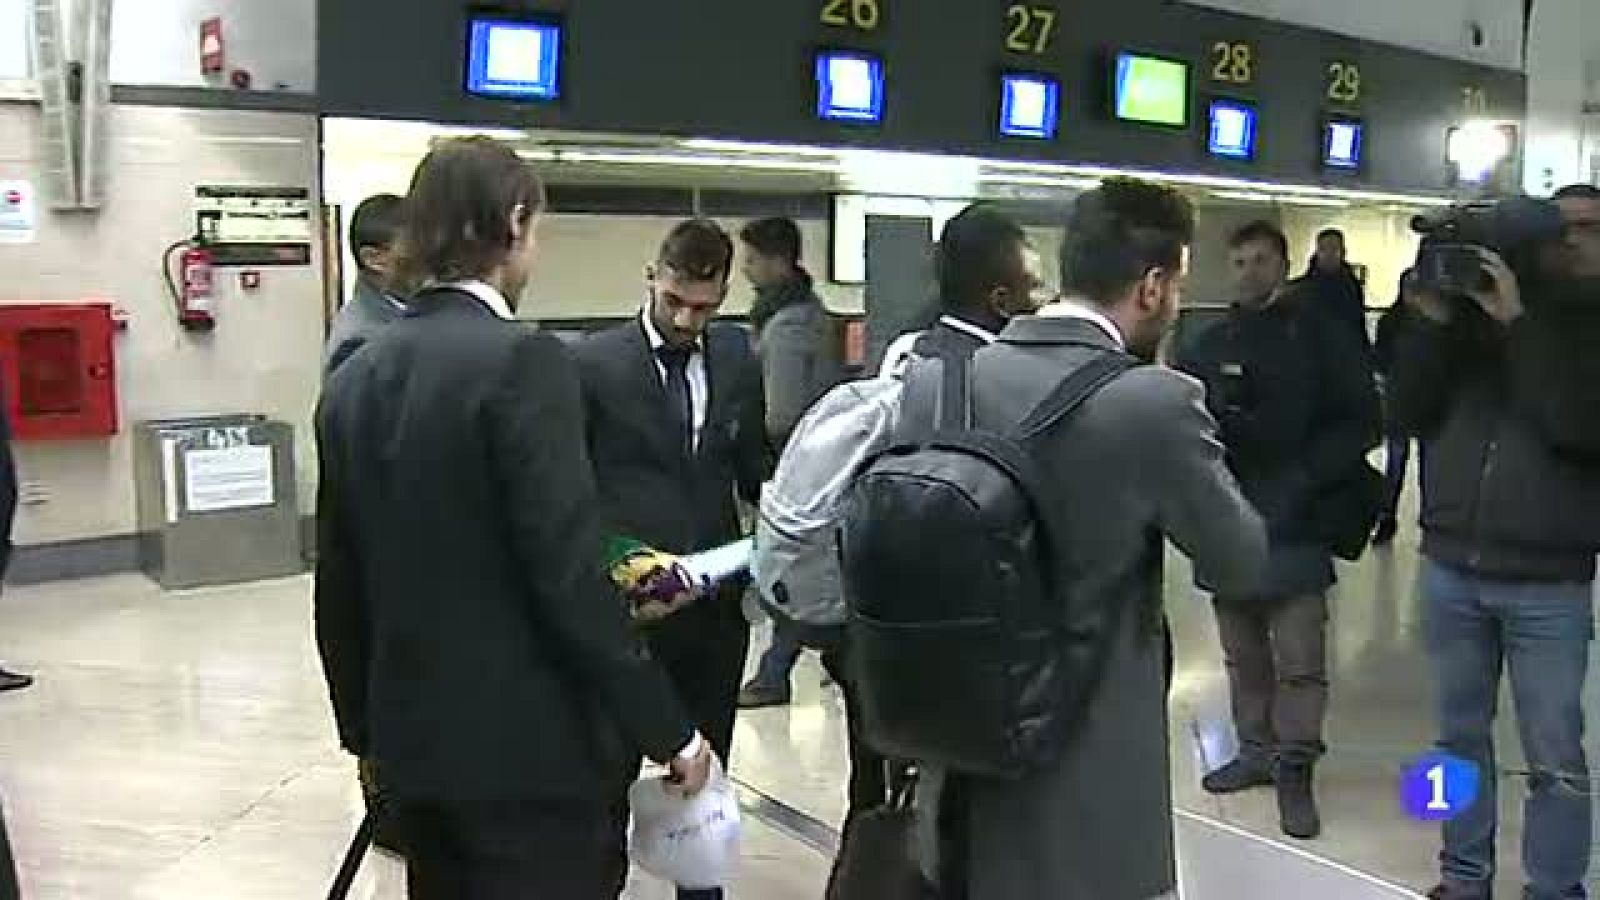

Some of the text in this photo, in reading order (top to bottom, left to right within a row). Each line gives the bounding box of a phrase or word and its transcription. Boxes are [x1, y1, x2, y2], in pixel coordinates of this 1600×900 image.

[821, 0, 878, 28] 26
[1006, 4, 1053, 52] 27
[1213, 42, 1250, 81] 28
[1328, 62, 1359, 100] 29
